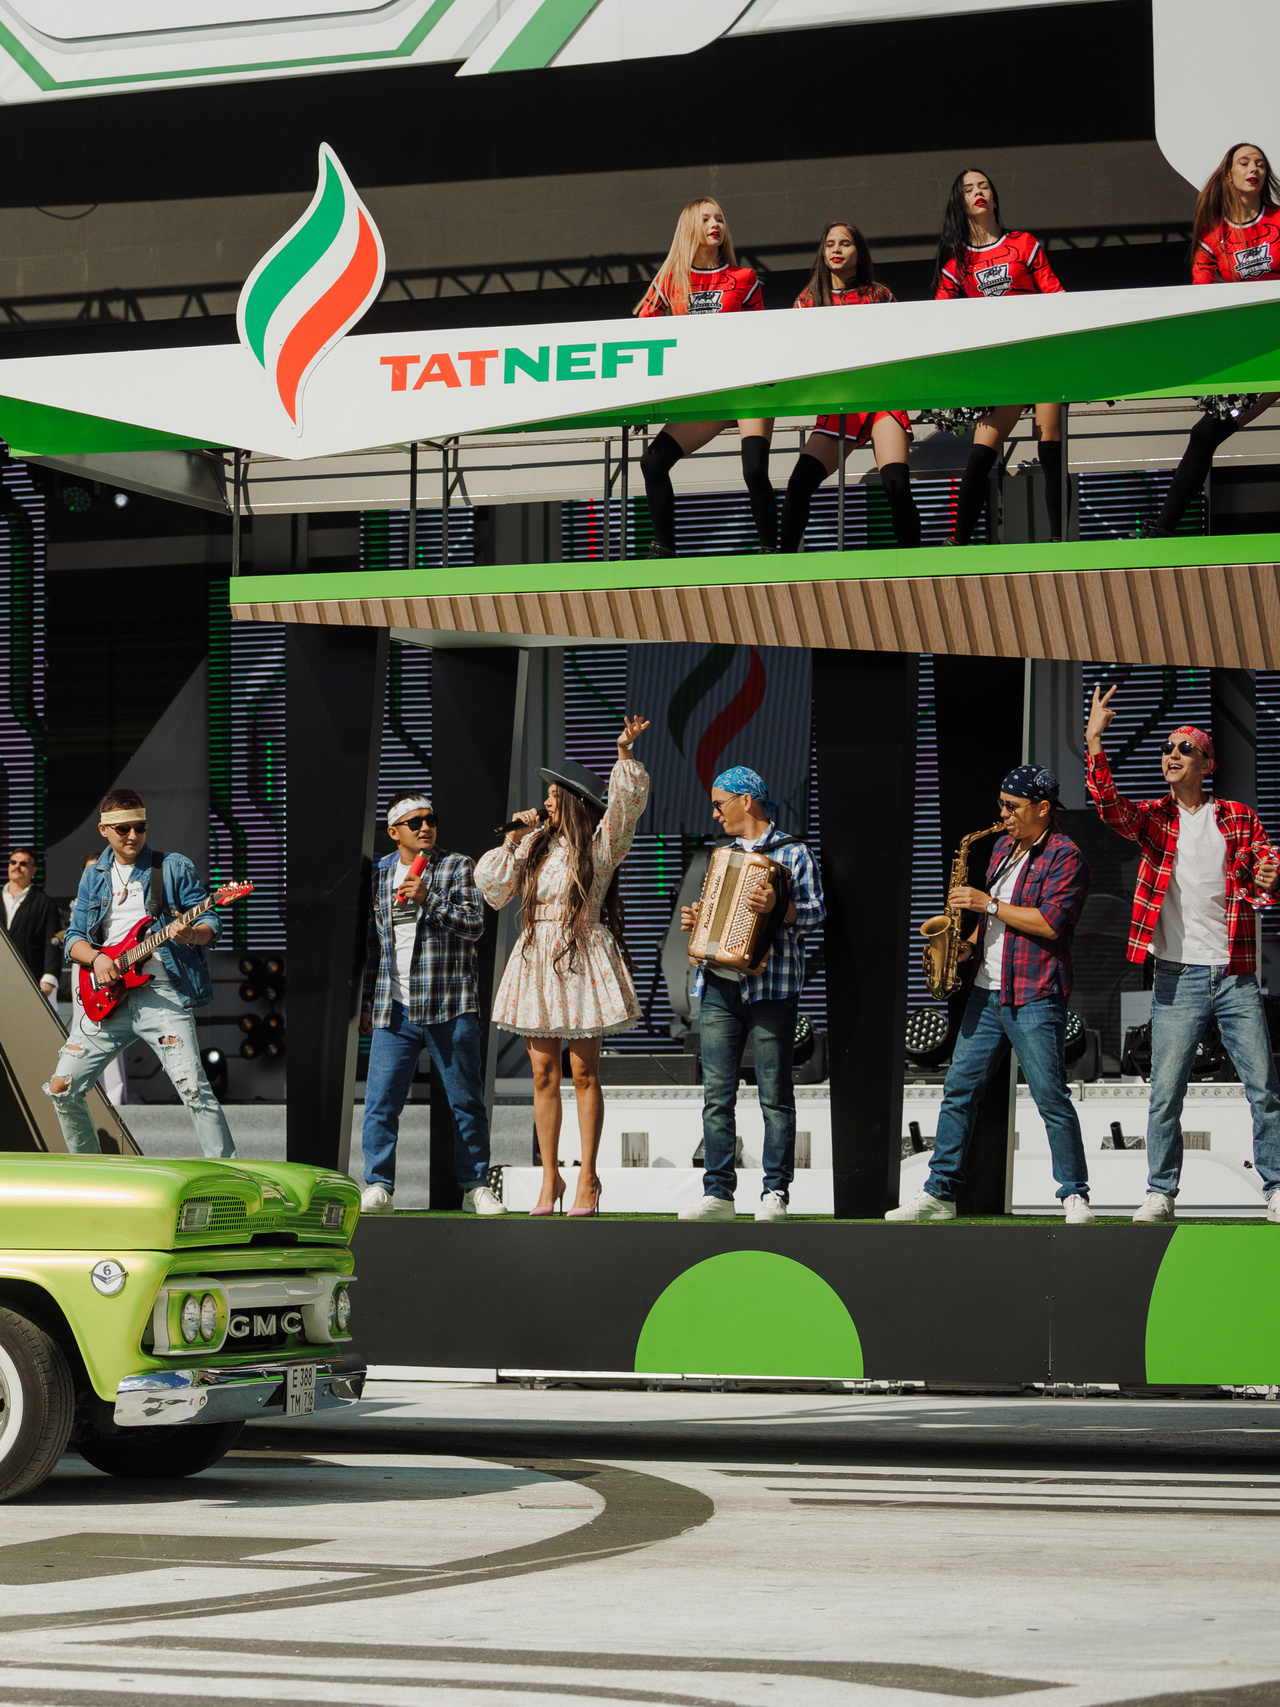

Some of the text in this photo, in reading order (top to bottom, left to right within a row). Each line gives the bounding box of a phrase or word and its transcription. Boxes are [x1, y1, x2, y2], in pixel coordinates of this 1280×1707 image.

[380, 339, 677, 391] TATNEFT
[103, 1265, 111, 1276] 6
[228, 1311, 302, 1338] GMC
[290, 1393, 301, 1414] TM
